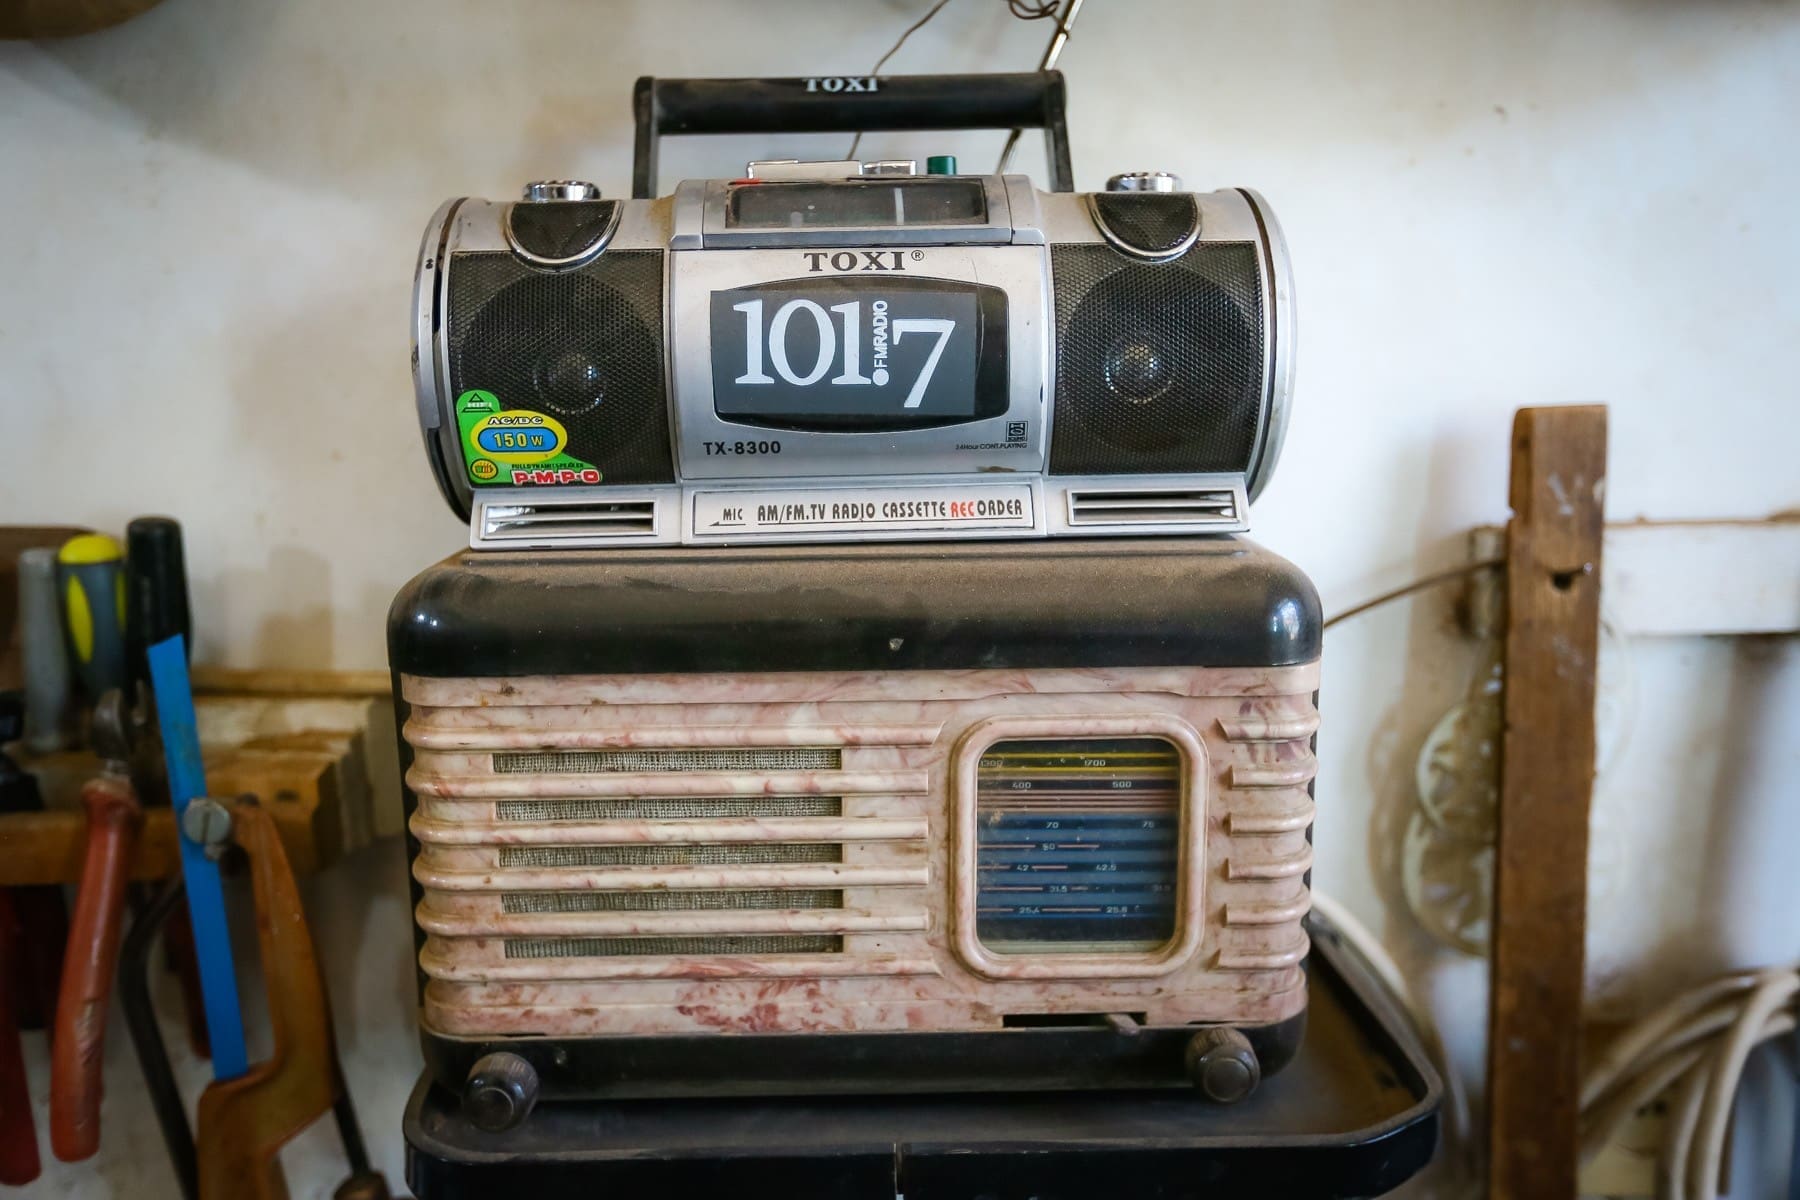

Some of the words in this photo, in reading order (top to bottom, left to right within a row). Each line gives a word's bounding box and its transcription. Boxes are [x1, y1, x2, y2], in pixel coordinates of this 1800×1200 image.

[803, 77, 878, 92] TOXI
[803, 252, 905, 271] TOXI
[488, 416, 543, 425] AC/DC
[494, 433, 528, 447] 150
[531, 435, 543, 446] W
[703, 441, 781, 455] TX-8300
[722, 508, 743, 521] MIC
[832, 502, 876, 520] RADIO
[882, 501, 946, 518] CASSETTE
[951, 499, 1022, 517] RECORDER
[1012, 781, 1031, 789] 400
[1112, 781, 1132, 789] 500
[1046, 821, 1059, 829] 70
[1016, 864, 1029, 872] 42
